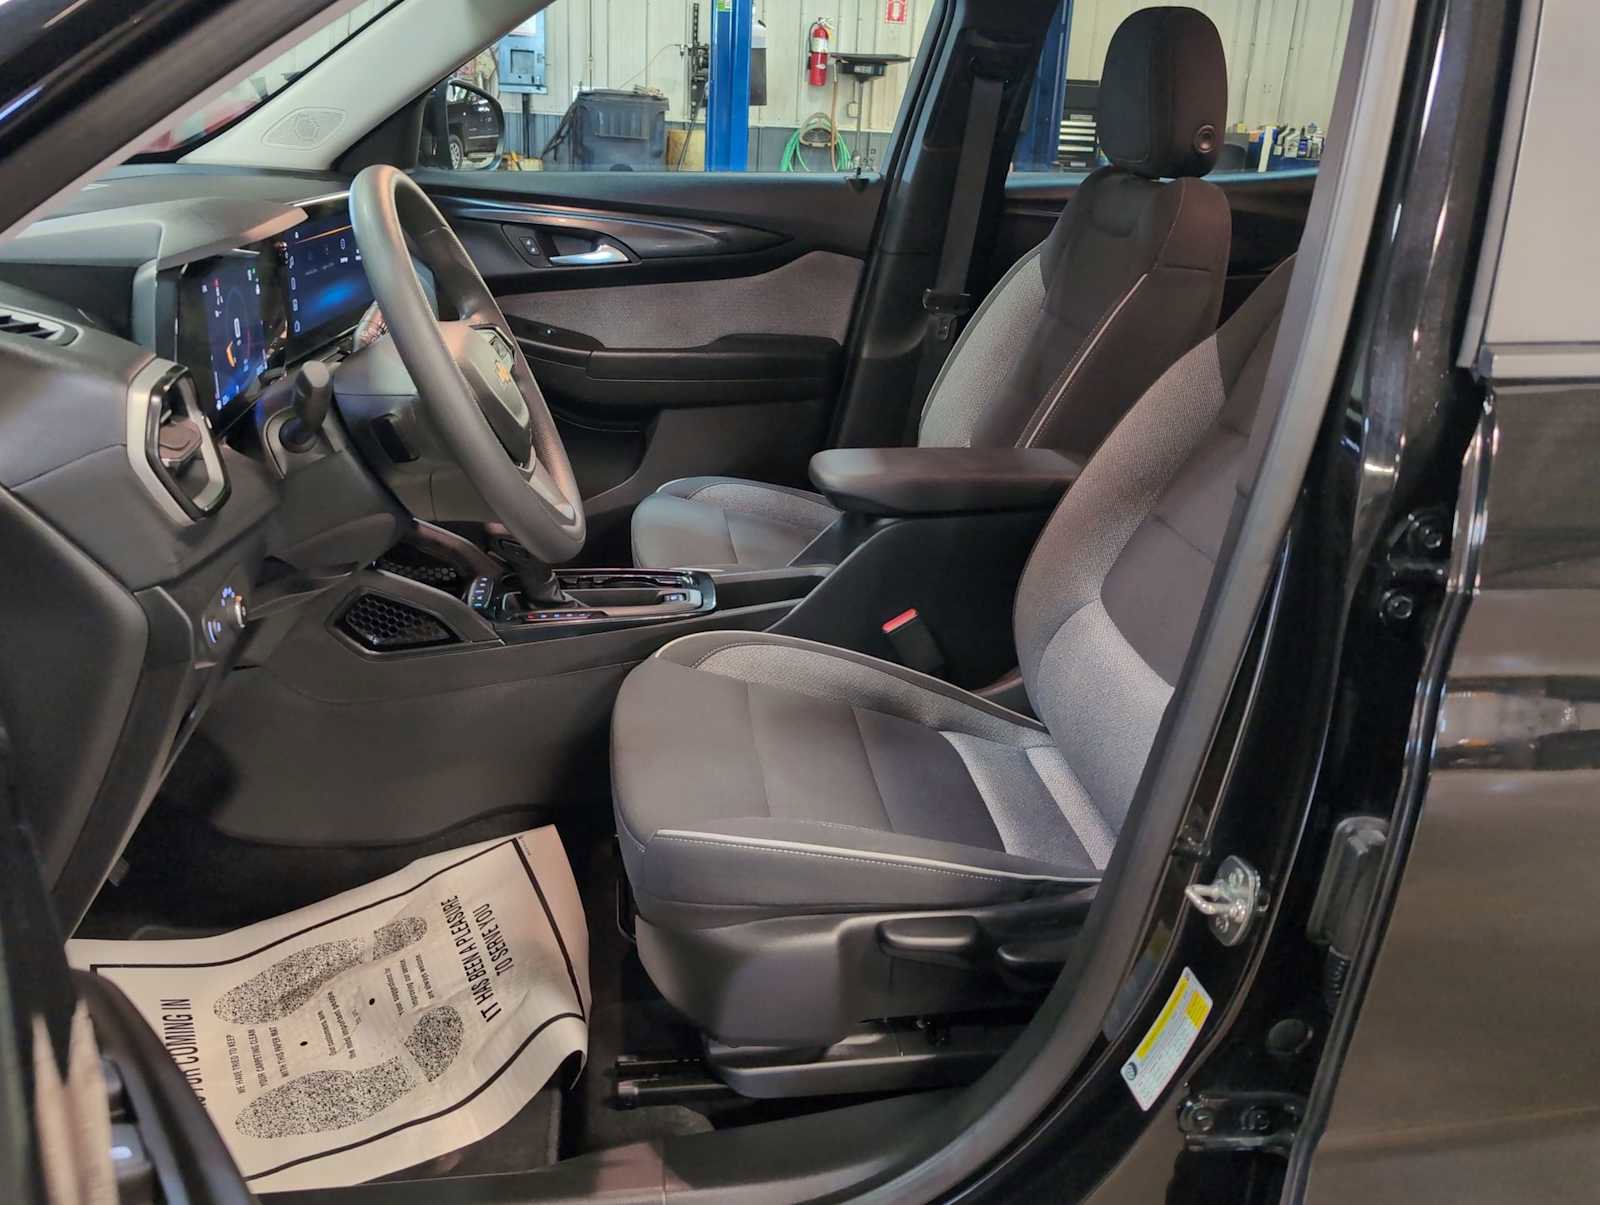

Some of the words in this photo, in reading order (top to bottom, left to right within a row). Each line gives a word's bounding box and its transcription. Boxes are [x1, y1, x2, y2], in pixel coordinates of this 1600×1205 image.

[440, 895, 474, 946] PLEASURE
[472, 902, 495, 930] YOU
[458, 942, 477, 955] A
[481, 924, 508, 961] SERVE
[461, 951, 486, 982] BEEN
[494, 956, 515, 976] TO
[470, 977, 493, 1005] HAS
[160, 998, 191, 1011] IN
[326, 991, 339, 1009] people
[480, 1000, 501, 1022] IT
[333, 1009, 350, 1036] important
[247, 1028, 258, 1044] CLEAN
[268, 1026, 278, 1037] MAT
[162, 1013, 198, 1066] COMING
[225, 1034, 235, 1047] KEEP
[271, 1037, 282, 1052] PAPER
[228, 1047, 237, 1055] TO
[250, 1044, 264, 1071] CARPETING
[275, 1051, 285, 1064] THIS
[230, 1055, 240, 1070] TRIED
[279, 1063, 289, 1077] WITH
[233, 1070, 243, 1085] HAVE
[257, 1072, 268, 1086] YOUR
[236, 1085, 245, 1093] WE
